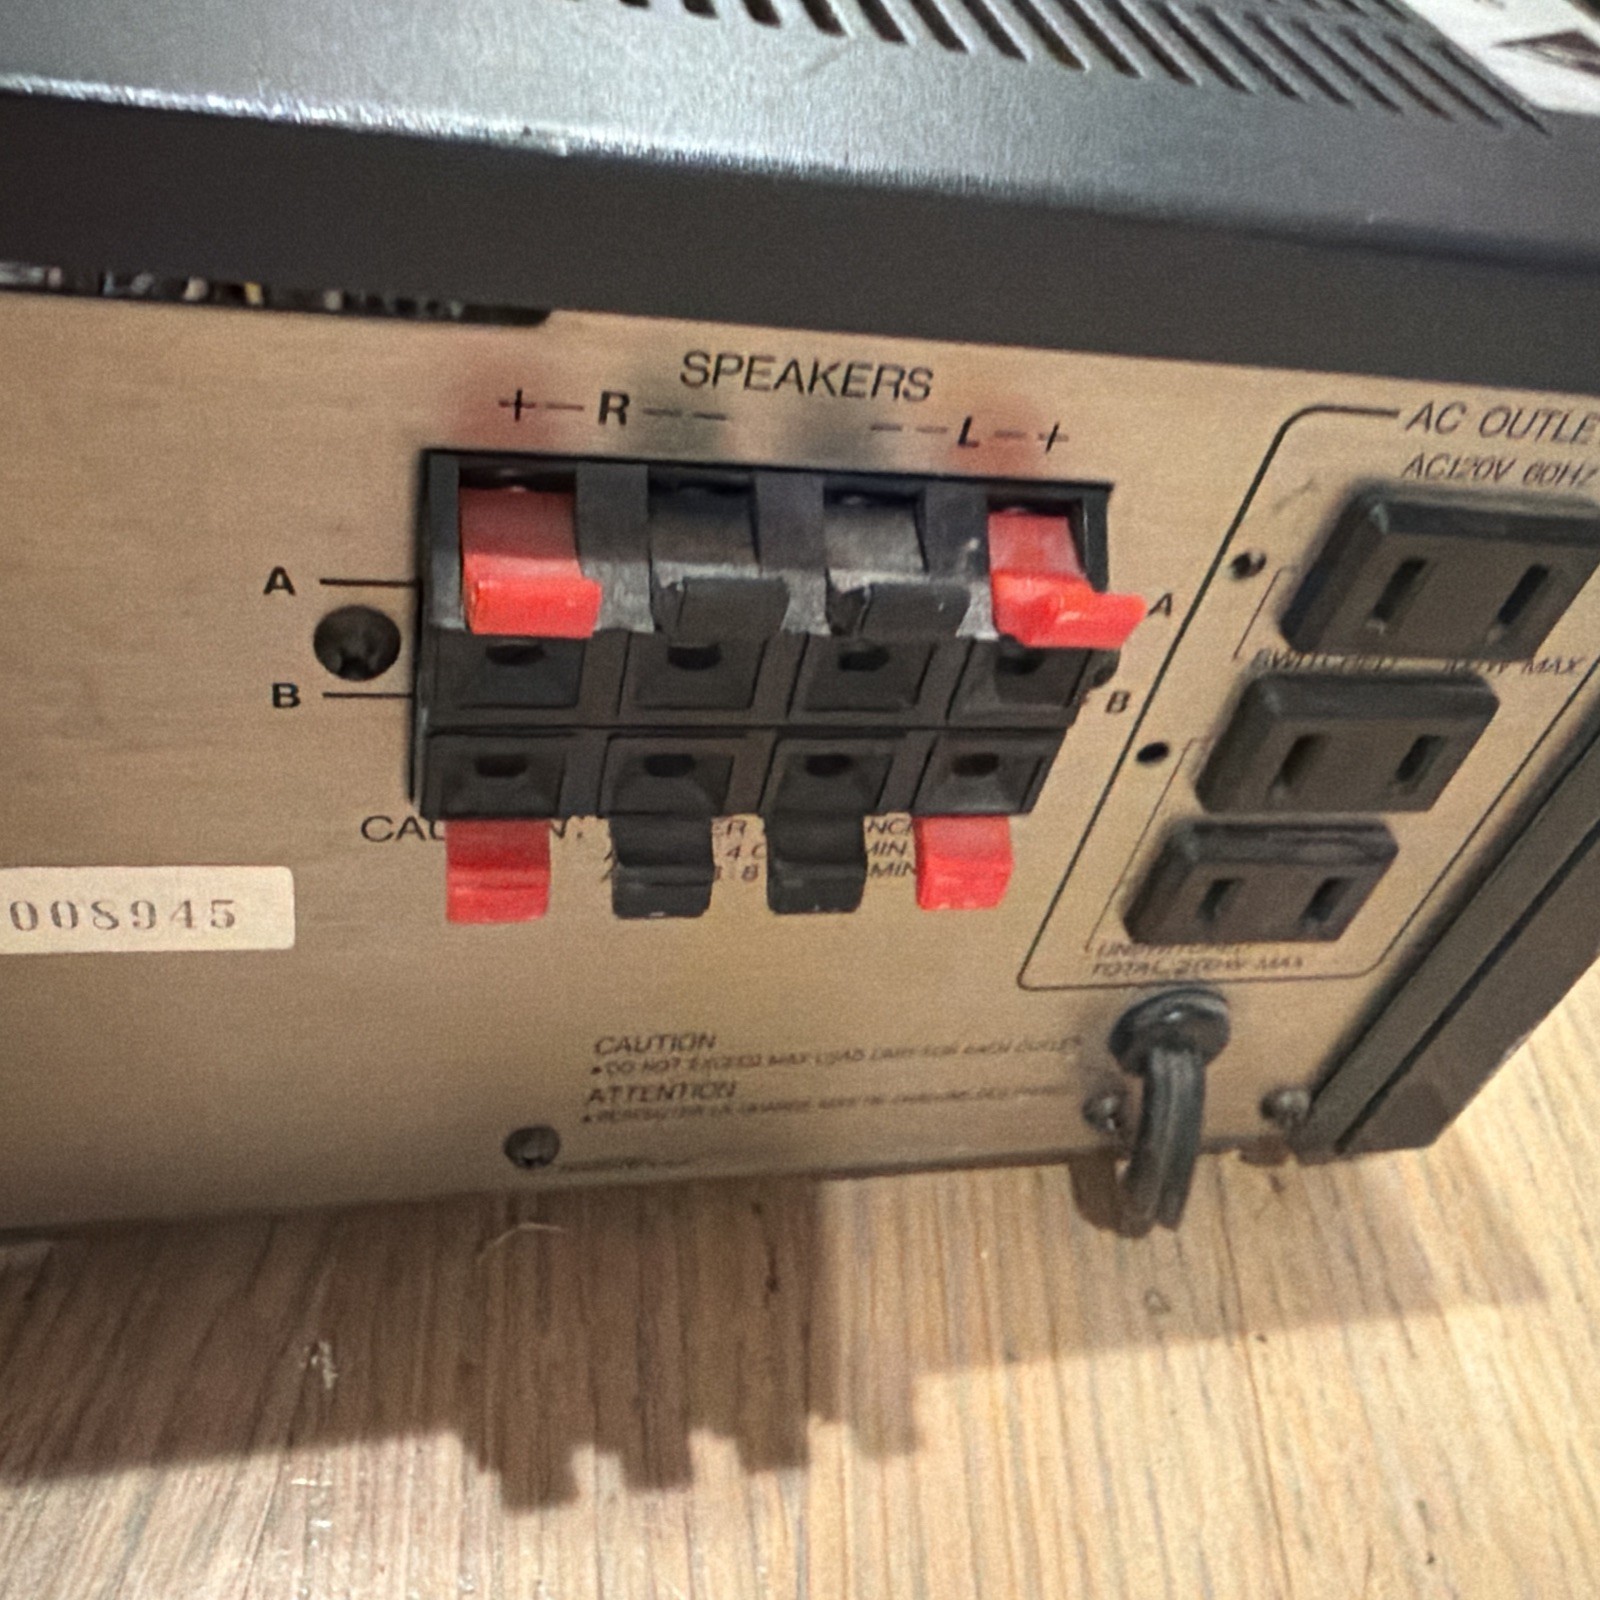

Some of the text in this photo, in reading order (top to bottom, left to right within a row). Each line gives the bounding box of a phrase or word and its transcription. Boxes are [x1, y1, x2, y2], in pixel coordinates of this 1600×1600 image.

[680, 350, 933, 401] SPEAKERS
[599, 390, 631, 426] R
[1404, 401, 1468, 435] AC
[957, 416, 981, 448] L
[263, 566, 297, 597] A
[1147, 592, 1173, 617] A
[272, 682, 302, 710] B
[1105, 690, 1132, 714] B
[8, 899, 237, 932] 008945
[593, 1031, 717, 1057] CAUTION
[588, 1080, 738, 1104] ATTENTION
